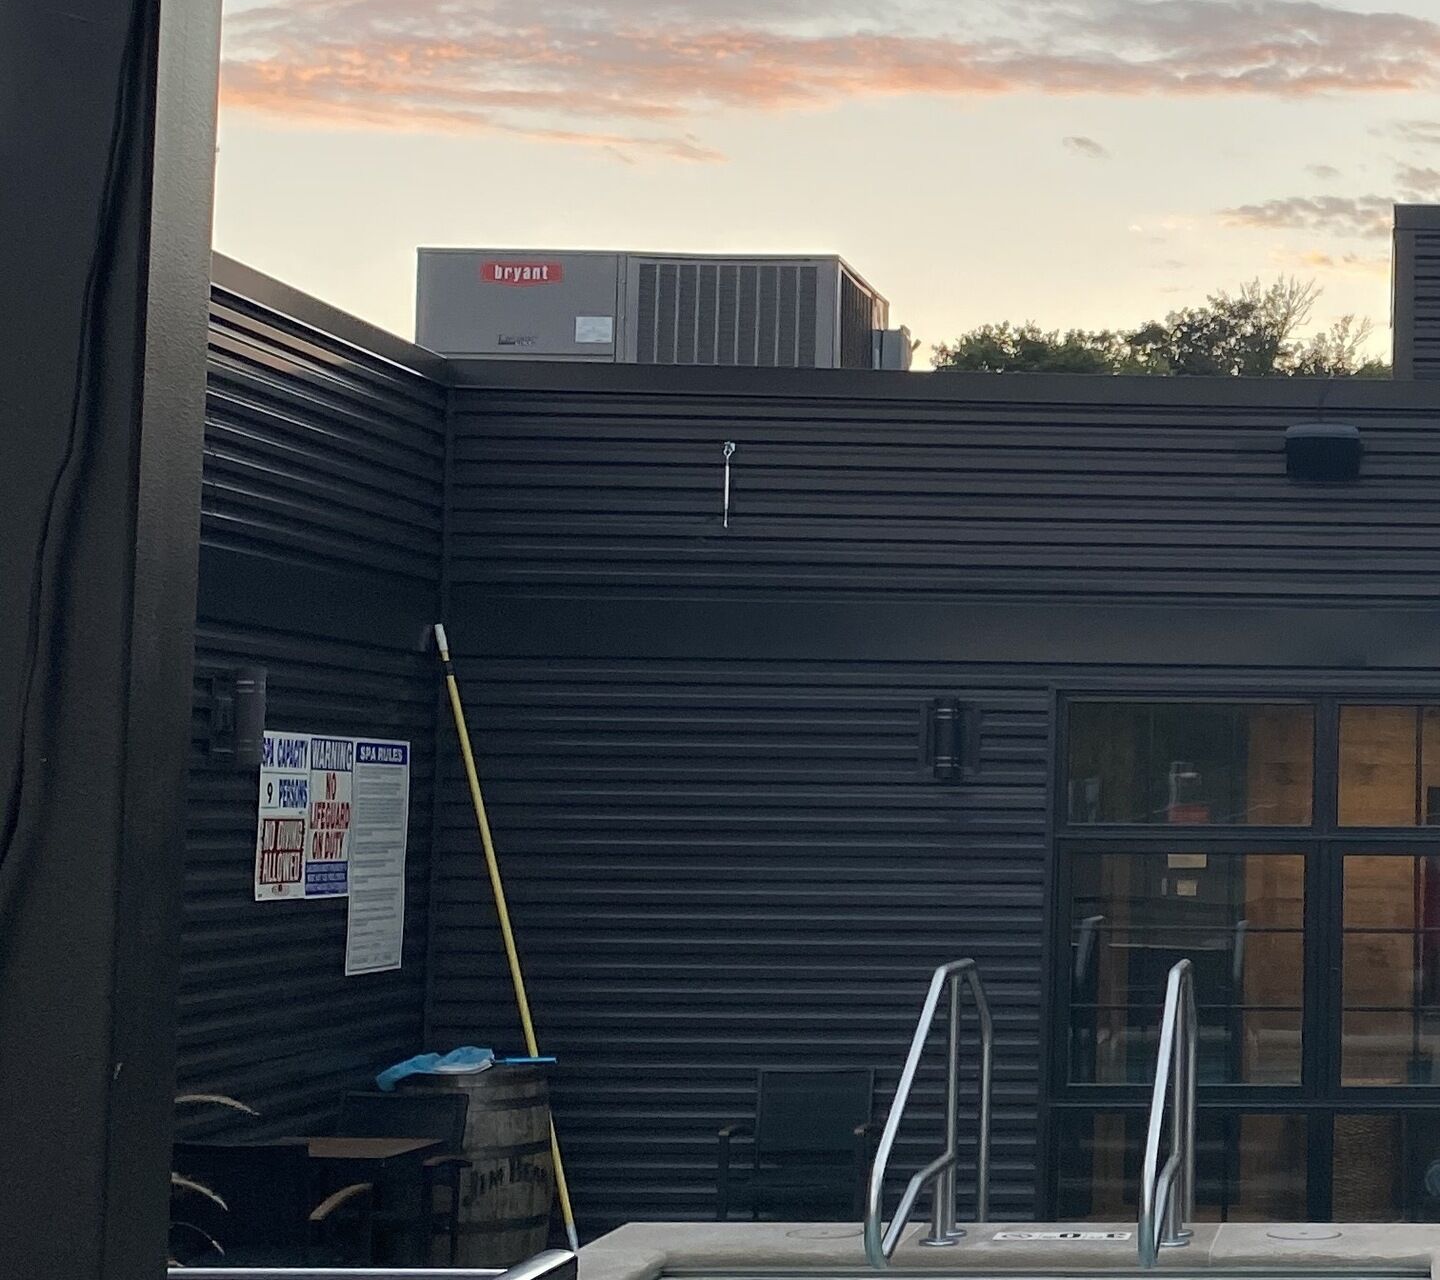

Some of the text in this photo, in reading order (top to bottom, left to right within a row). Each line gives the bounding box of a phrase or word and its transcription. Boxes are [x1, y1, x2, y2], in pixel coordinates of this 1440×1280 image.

[494, 265, 549, 282] bryant
[277, 739, 308, 768] CAPACITY
[312, 740, 353, 770] WARNING
[360, 745, 403, 762] SPA RULES
[267, 779, 308, 808] 9 PERSONS
[325, 772, 337, 800] NO
[310, 802, 350, 829] LIFEGUARD
[264, 821, 275, 850] NO
[312, 831, 324, 860] ON
[325, 831, 345, 859] DUTY
[261, 852, 301, 883] ALLOWED
